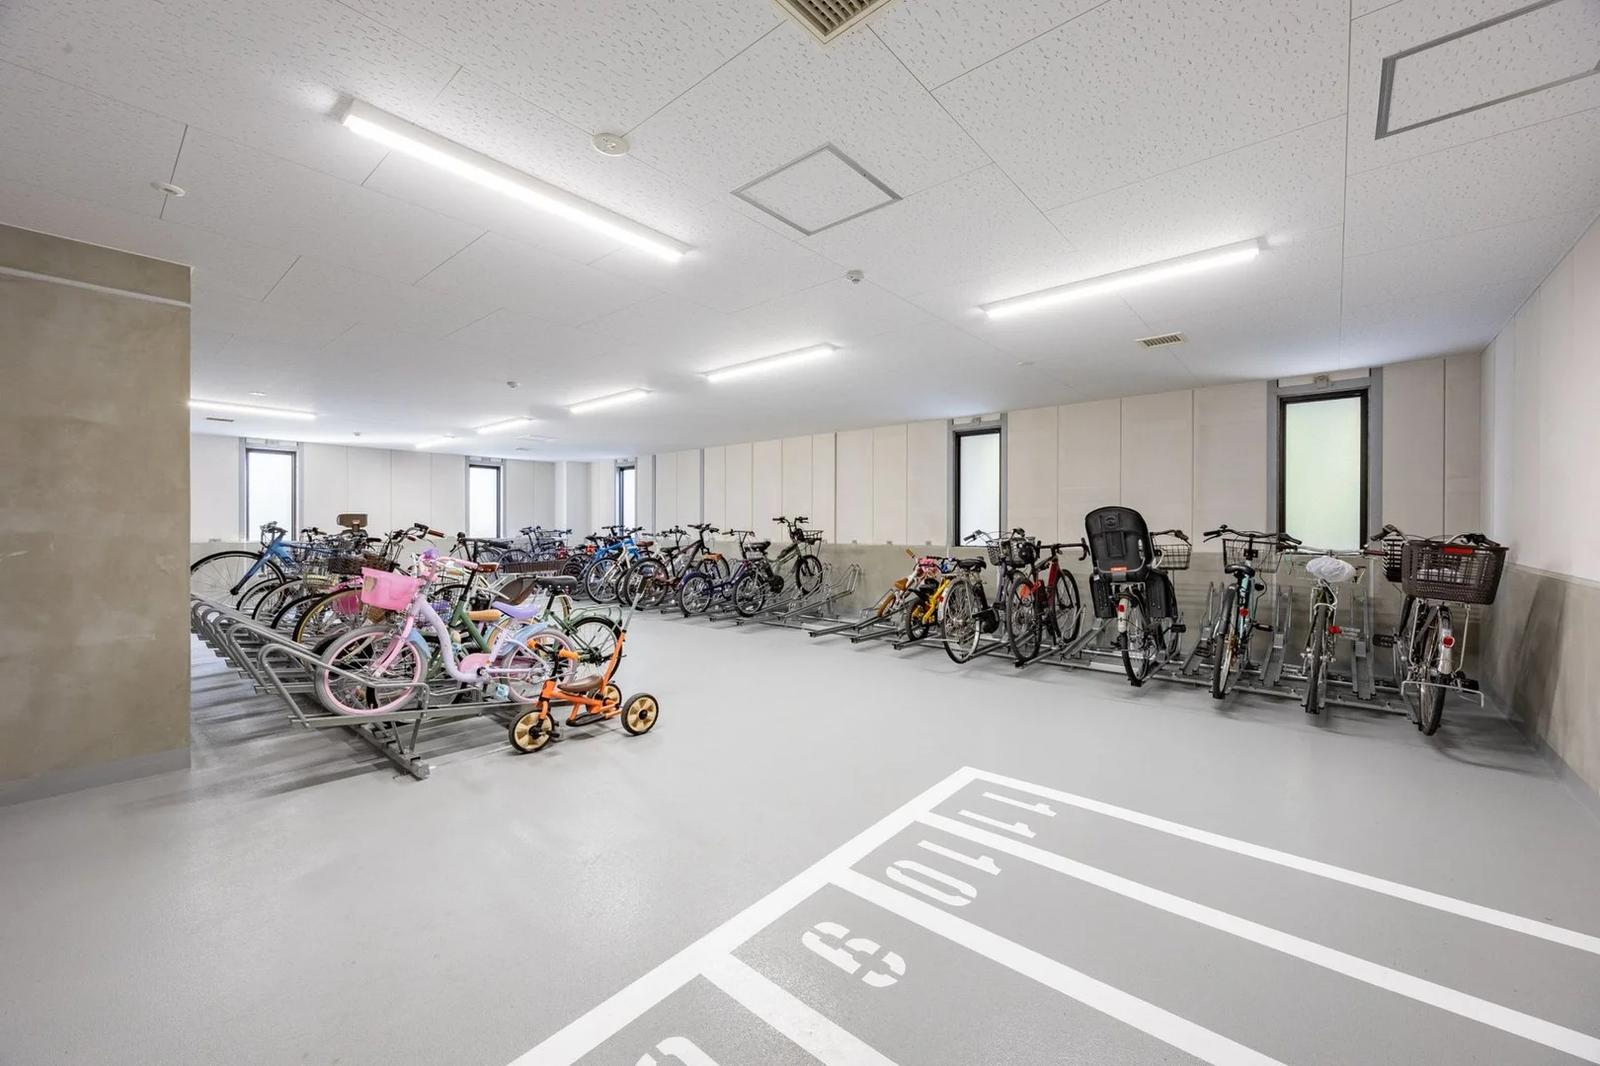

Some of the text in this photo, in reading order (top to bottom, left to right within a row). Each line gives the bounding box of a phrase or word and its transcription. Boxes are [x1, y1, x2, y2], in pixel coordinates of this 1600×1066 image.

[957, 791, 1057, 839] 11
[885, 839, 1002, 907] 10
[801, 921, 906, 988] 9
